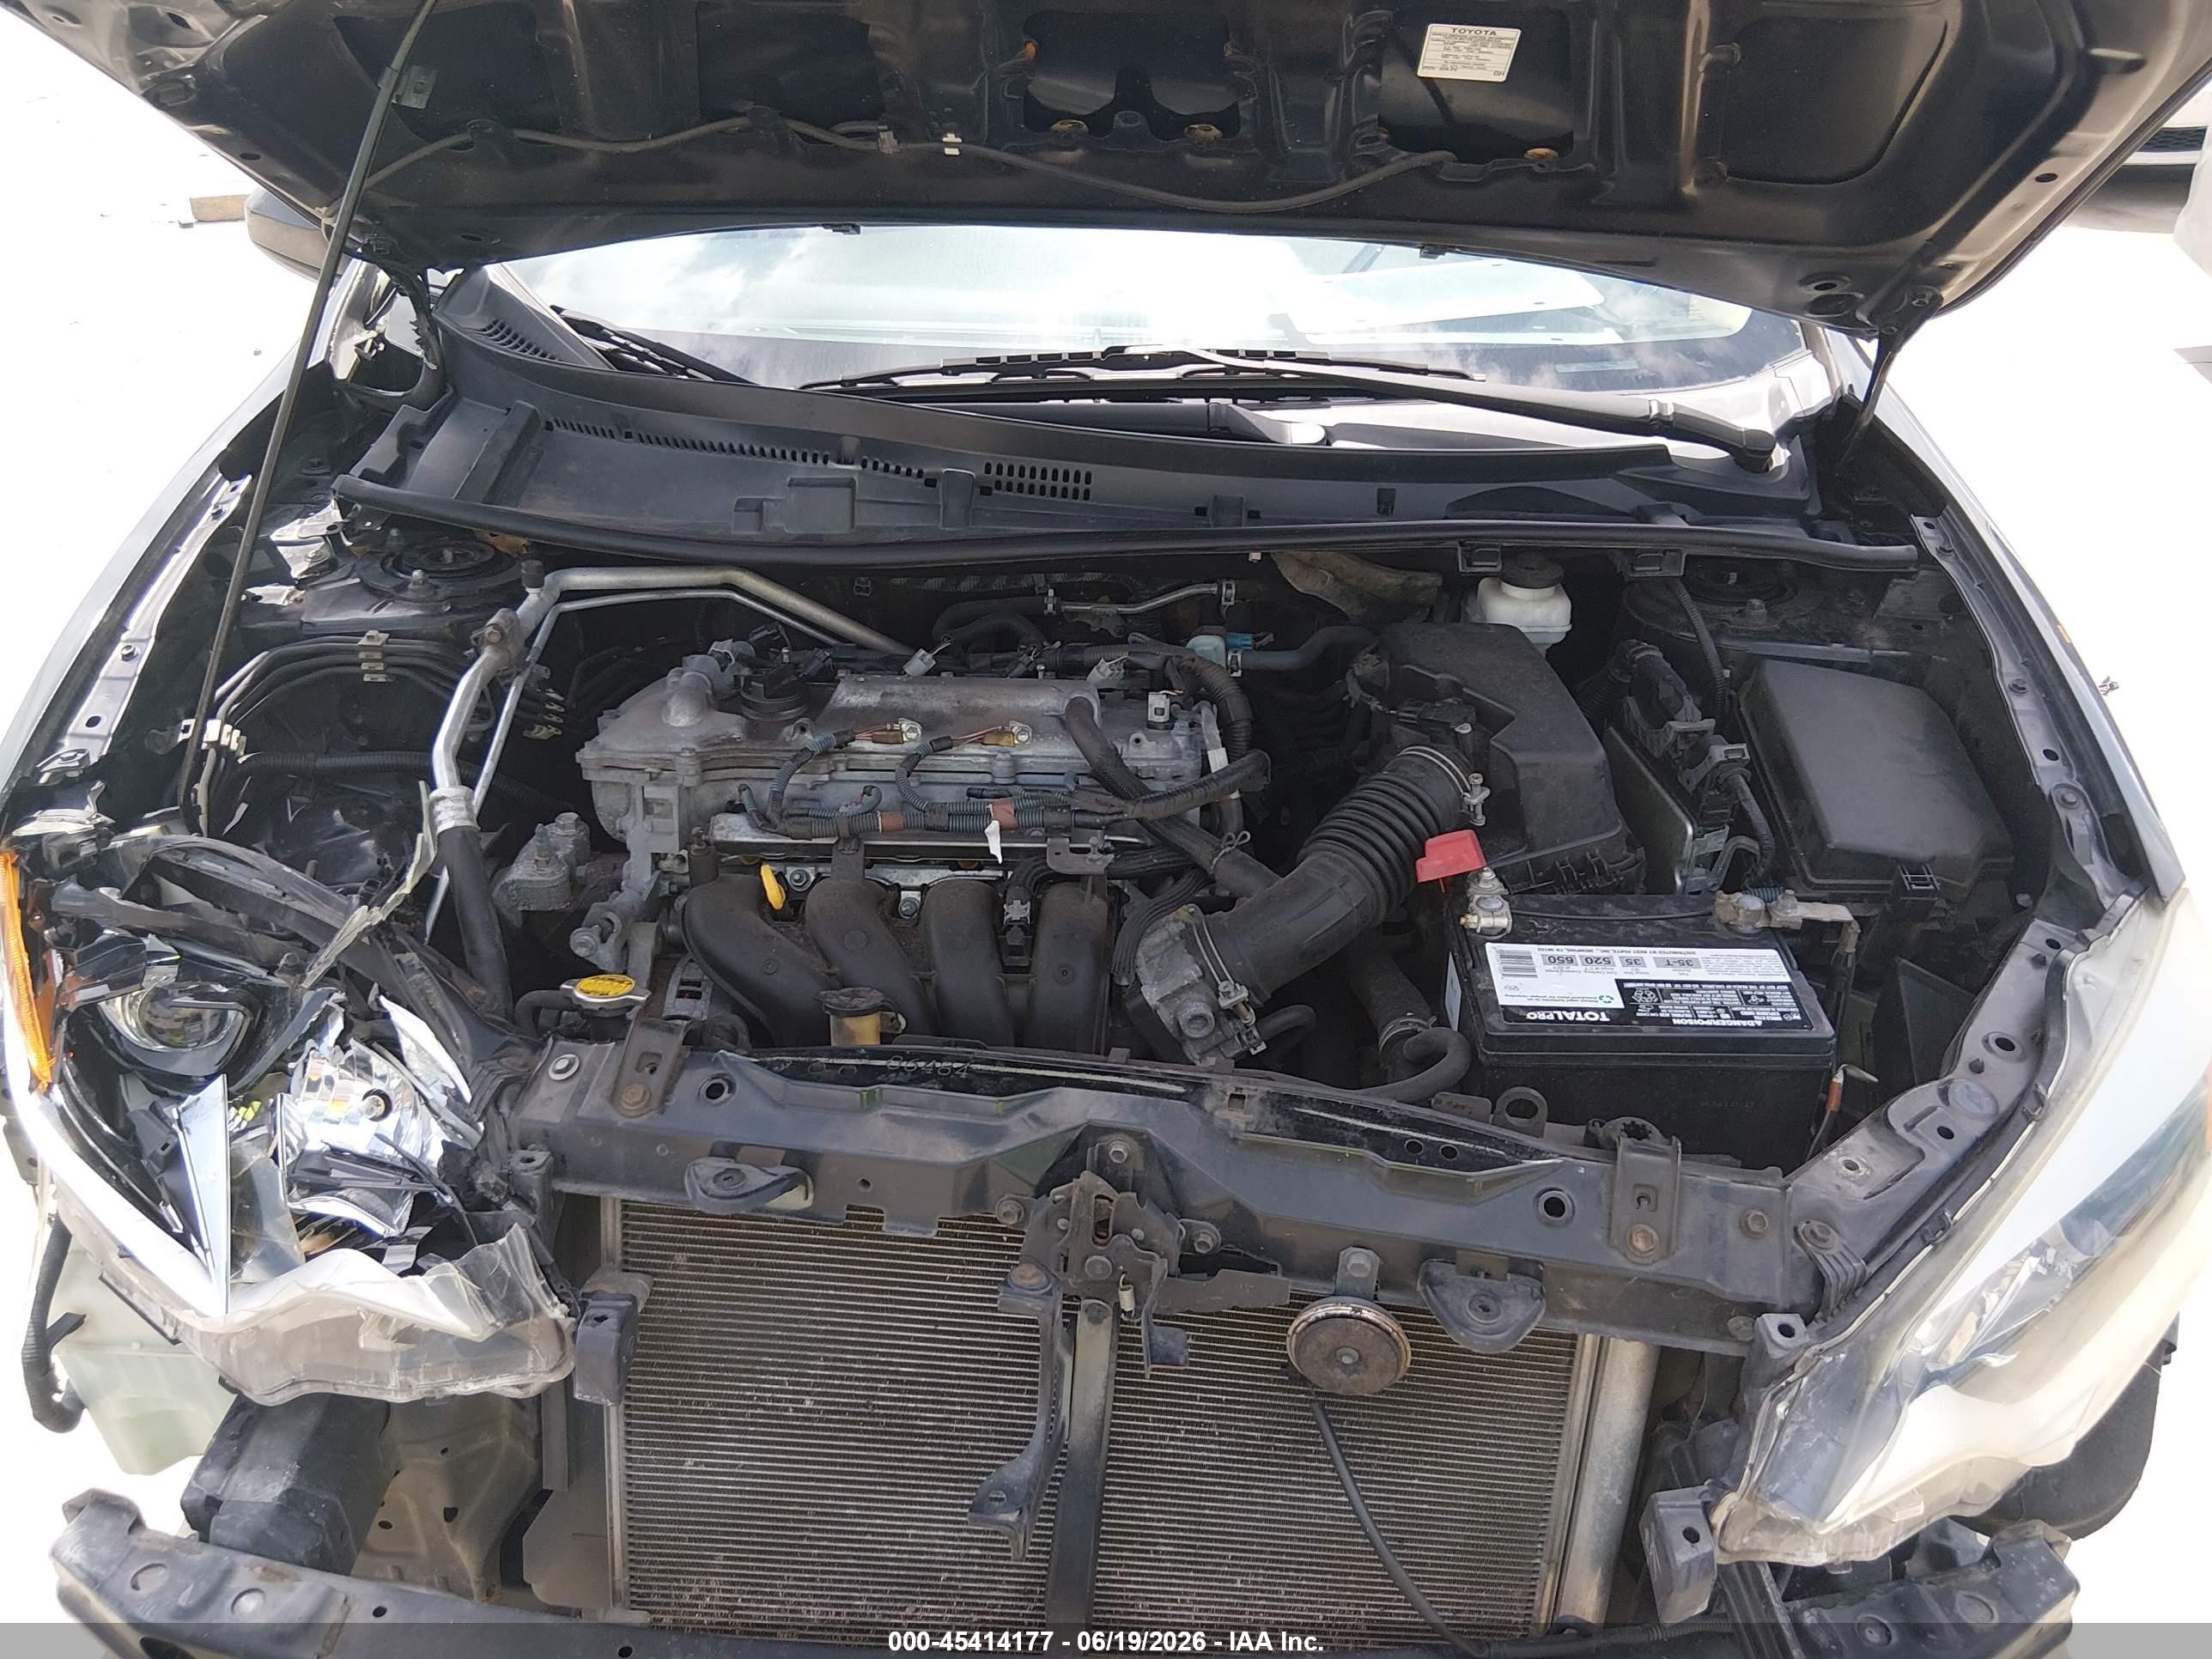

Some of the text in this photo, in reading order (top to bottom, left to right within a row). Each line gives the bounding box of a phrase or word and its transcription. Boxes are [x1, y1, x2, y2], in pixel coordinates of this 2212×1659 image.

[1547, 956, 1574, 964] 650
[1584, 957, 1611, 965] 520
[1526, 1011, 1610, 1022] TOTALPRO
